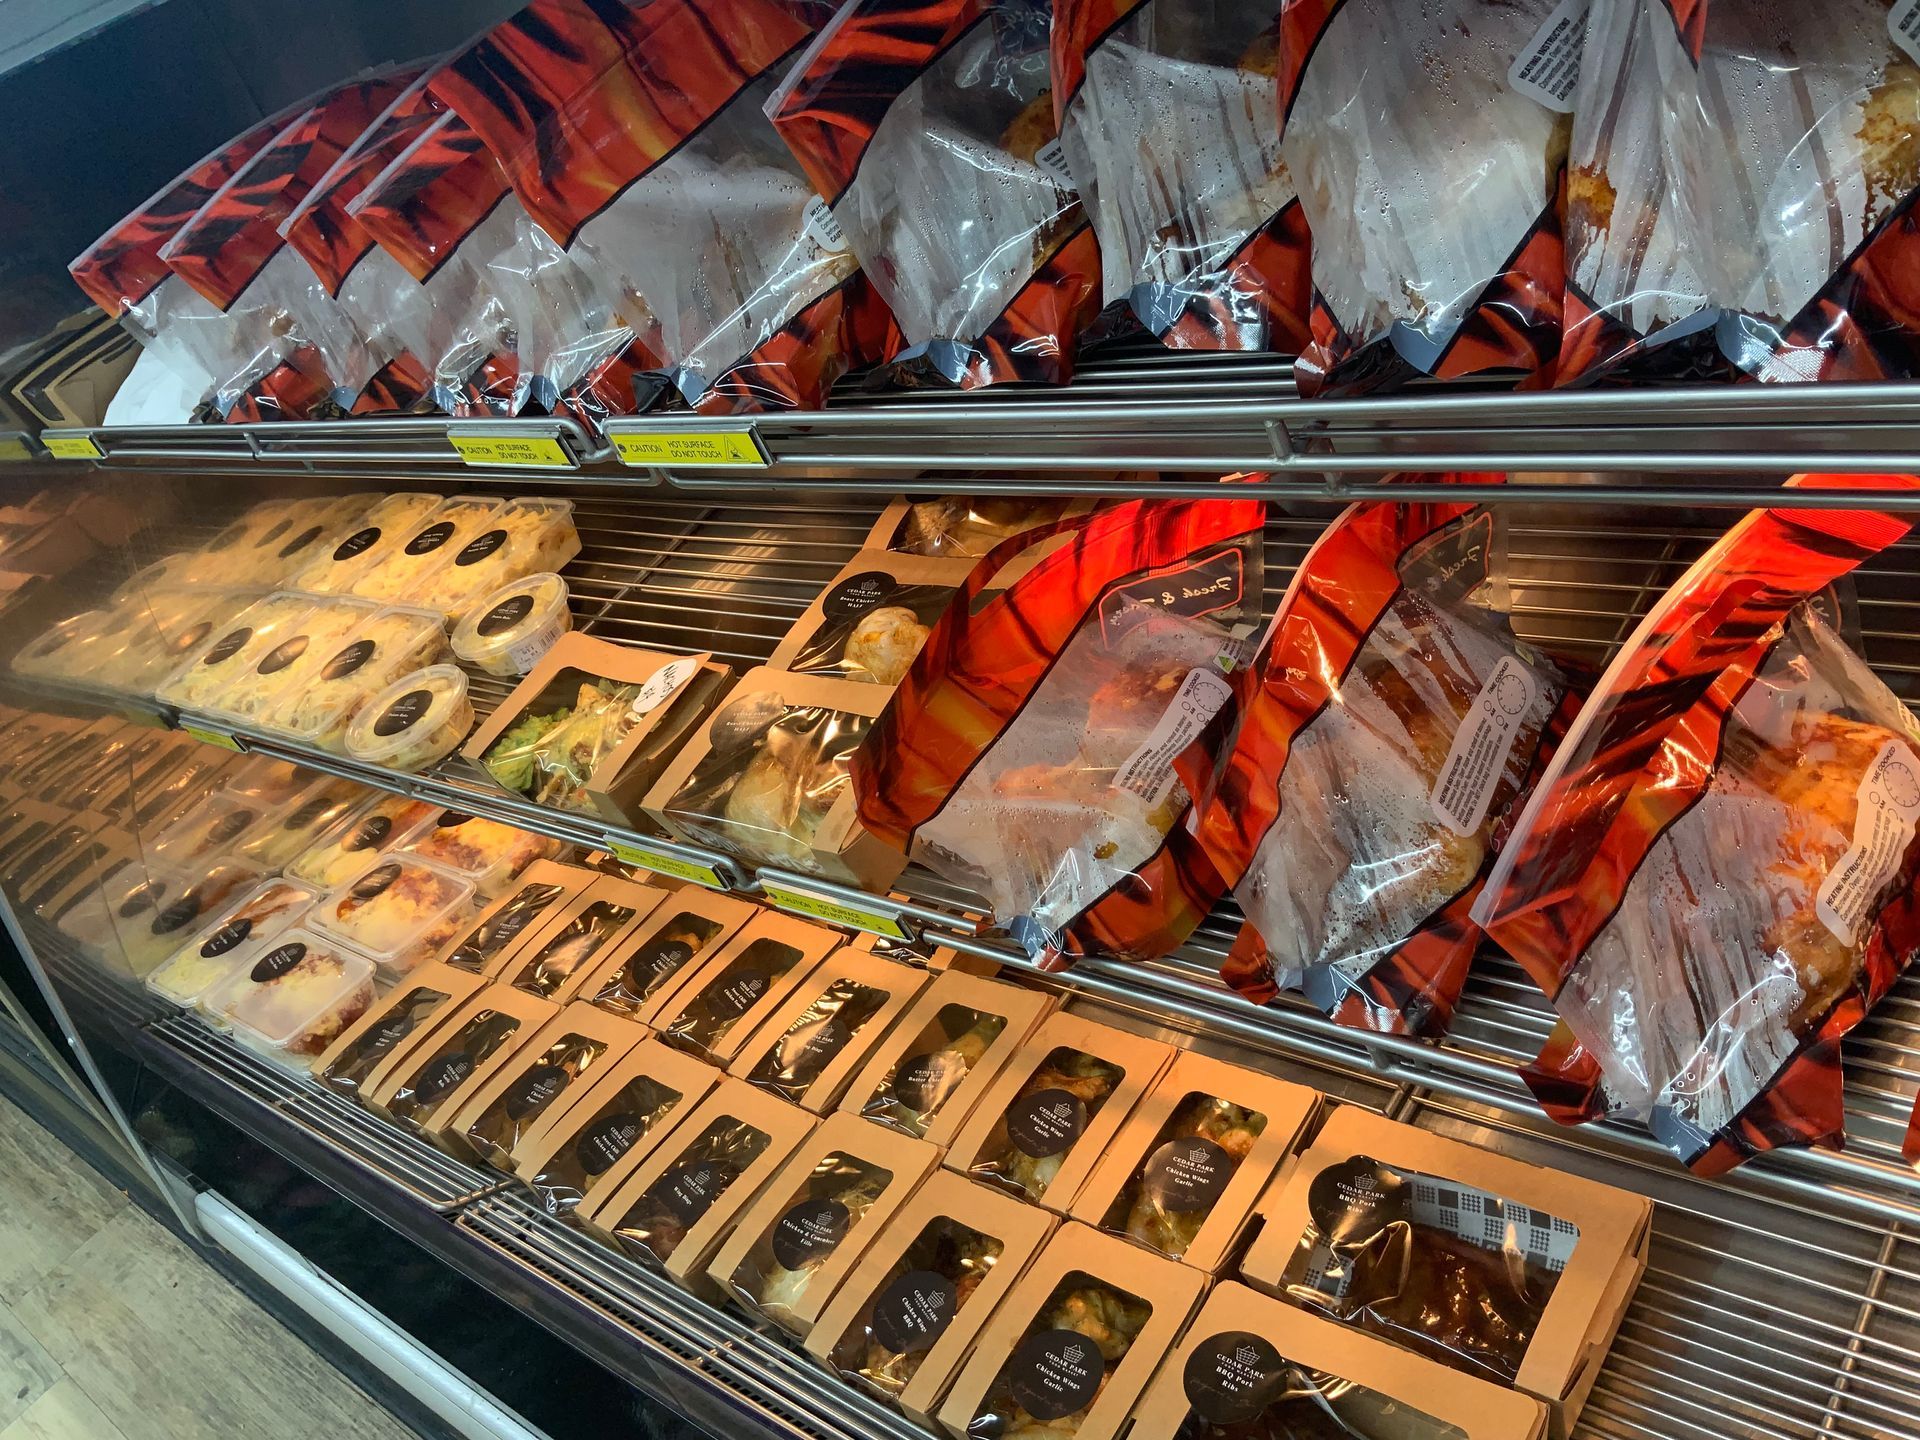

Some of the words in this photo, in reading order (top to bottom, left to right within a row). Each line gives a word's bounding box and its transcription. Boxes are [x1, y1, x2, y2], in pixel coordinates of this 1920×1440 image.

[1518, 55, 1542, 79] HEATING
[1537, 18, 1570, 56] INSTRUCTIONS
[630, 444, 663, 452] CAUTION
[1189, 672, 1200, 690] COOKED
[1487, 682, 1499, 694] TIME
[1495, 662, 1509, 682] COOKED
[1128, 748, 1151, 776] INSTRUCTIONS
[1872, 771, 1881, 784] TIME
[1878, 746, 1896, 772] COOKED
[1438, 785, 1449, 804] HEATING
[1446, 754, 1462, 785] INSTRUCTIONS
[1826, 882, 1844, 906] HEATING
[1840, 846, 1868, 884] INSTRUCTIONS
[740, 981, 750, 991] CEDAR
[724, 989, 735, 1001] Chicken
[1030, 1115, 1049, 1129] Chicken
[1050, 1126, 1063, 1137] Wings
[1039, 1107, 1057, 1120] CEDAR
[1058, 1118, 1072, 1128] PARK
[602, 1135, 611, 1146] Sweet
[611, 1127, 622, 1139] CEDAR
[1035, 1126, 1050, 1138] Garlic
[594, 1137, 606, 1151] Chicken
[1173, 1157, 1195, 1167] CEDAR
[1197, 1164, 1214, 1172] PARK
[1166, 1167, 1189, 1178] Chicken
[1192, 1175, 1209, 1184] Wings
[1175, 1178, 1193, 1187] Garlic
[684, 1175, 696, 1187] CEDAR
[695, 1185, 706, 1195] PARK
[1337, 1182, 1362, 1194] CEDAR
[674, 1186, 683, 1197] Wing
[682, 1194, 692, 1205] Dings
[1339, 1194, 1356, 1204] BBQ
[1347, 1205, 1362, 1213] Ribs
[783, 1220, 804, 1234] Chicken
[802, 1218, 819, 1229] CEDAR
[902, 1297, 917, 1318] Chicken
[917, 1318, 927, 1332] Wings
[914, 1290, 928, 1309] CEDAR
[927, 1309, 939, 1322] PARK
[903, 1314, 913, 1328] BBQ
[1045, 1351, 1068, 1367] CEDAR
[1070, 1365, 1088, 1376] PARK
[1217, 1353, 1242, 1369] CEDAR
[1245, 1367, 1266, 1379] PARK
[1036, 1363, 1060, 1380] Chicken
[1063, 1377, 1080, 1390] Wings
[1044, 1378, 1064, 1392] Garlic
[1216, 1366, 1234, 1380] BBQ
[1236, 1376, 1253, 1388] Pork
[1222, 1380, 1239, 1392] Ribs
